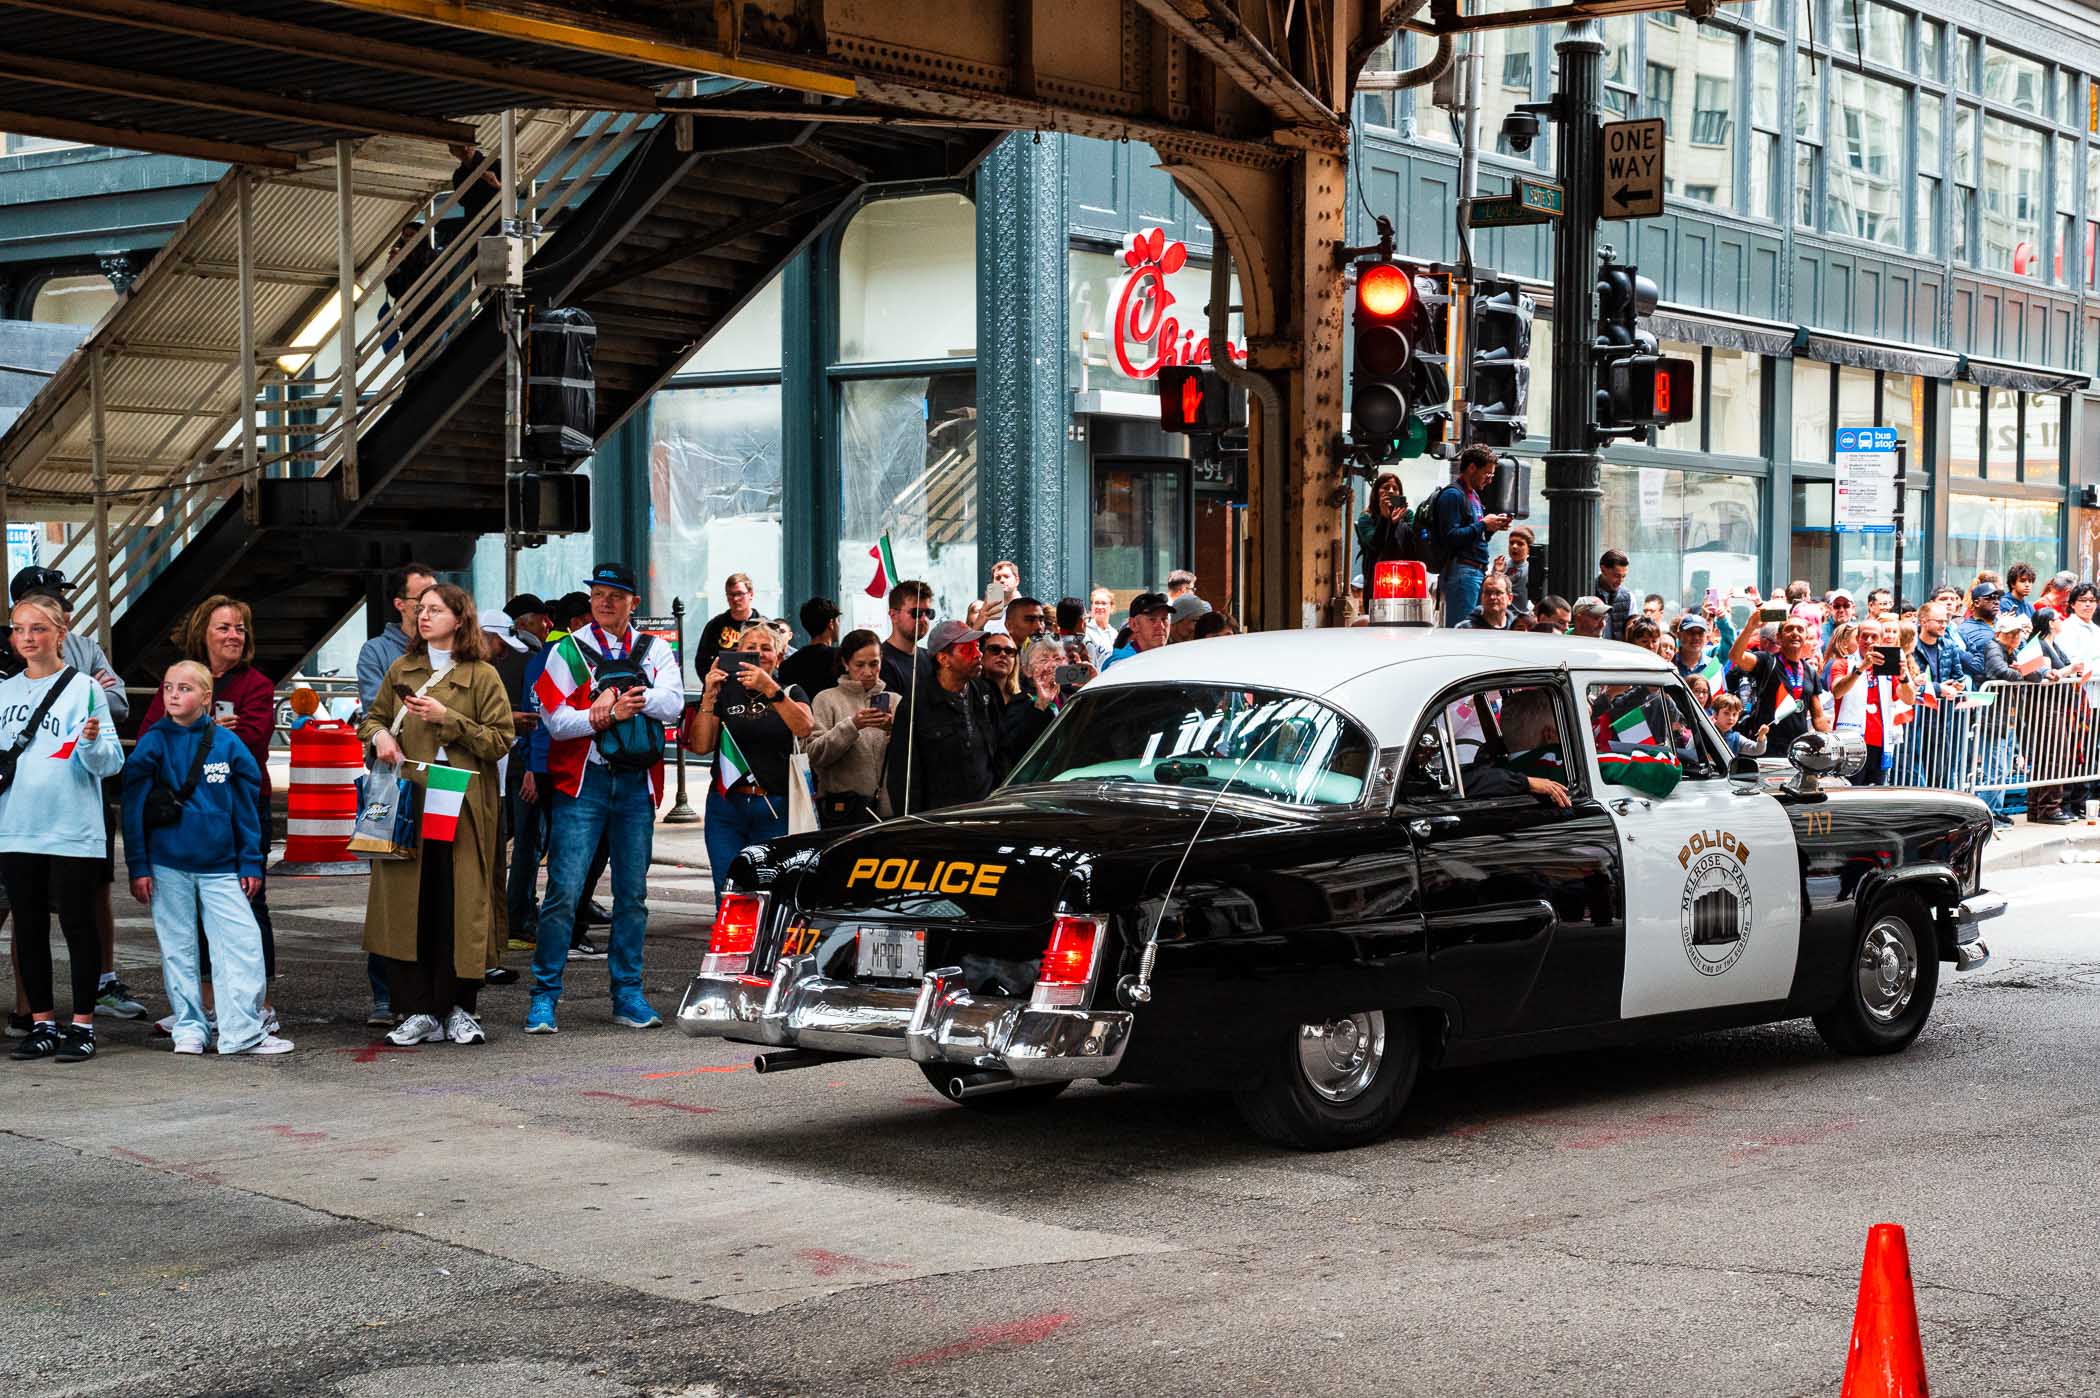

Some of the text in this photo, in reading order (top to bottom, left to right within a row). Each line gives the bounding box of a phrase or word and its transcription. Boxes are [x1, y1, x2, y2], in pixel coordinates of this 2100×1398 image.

[1610, 127, 1655, 152] ONE
[1609, 154, 1656, 179] WAY
[1874, 431, 1892, 440] bus
[1874, 440, 1895, 450] stop
[0, 704, 60, 738] HICGO
[1801, 811, 1833, 837] 717
[1677, 829, 1750, 871] POLICE
[846, 858, 1008, 897] POLICE
[1682, 855, 1751, 912] MELROSE PARK
[782, 927, 822, 957] 717
